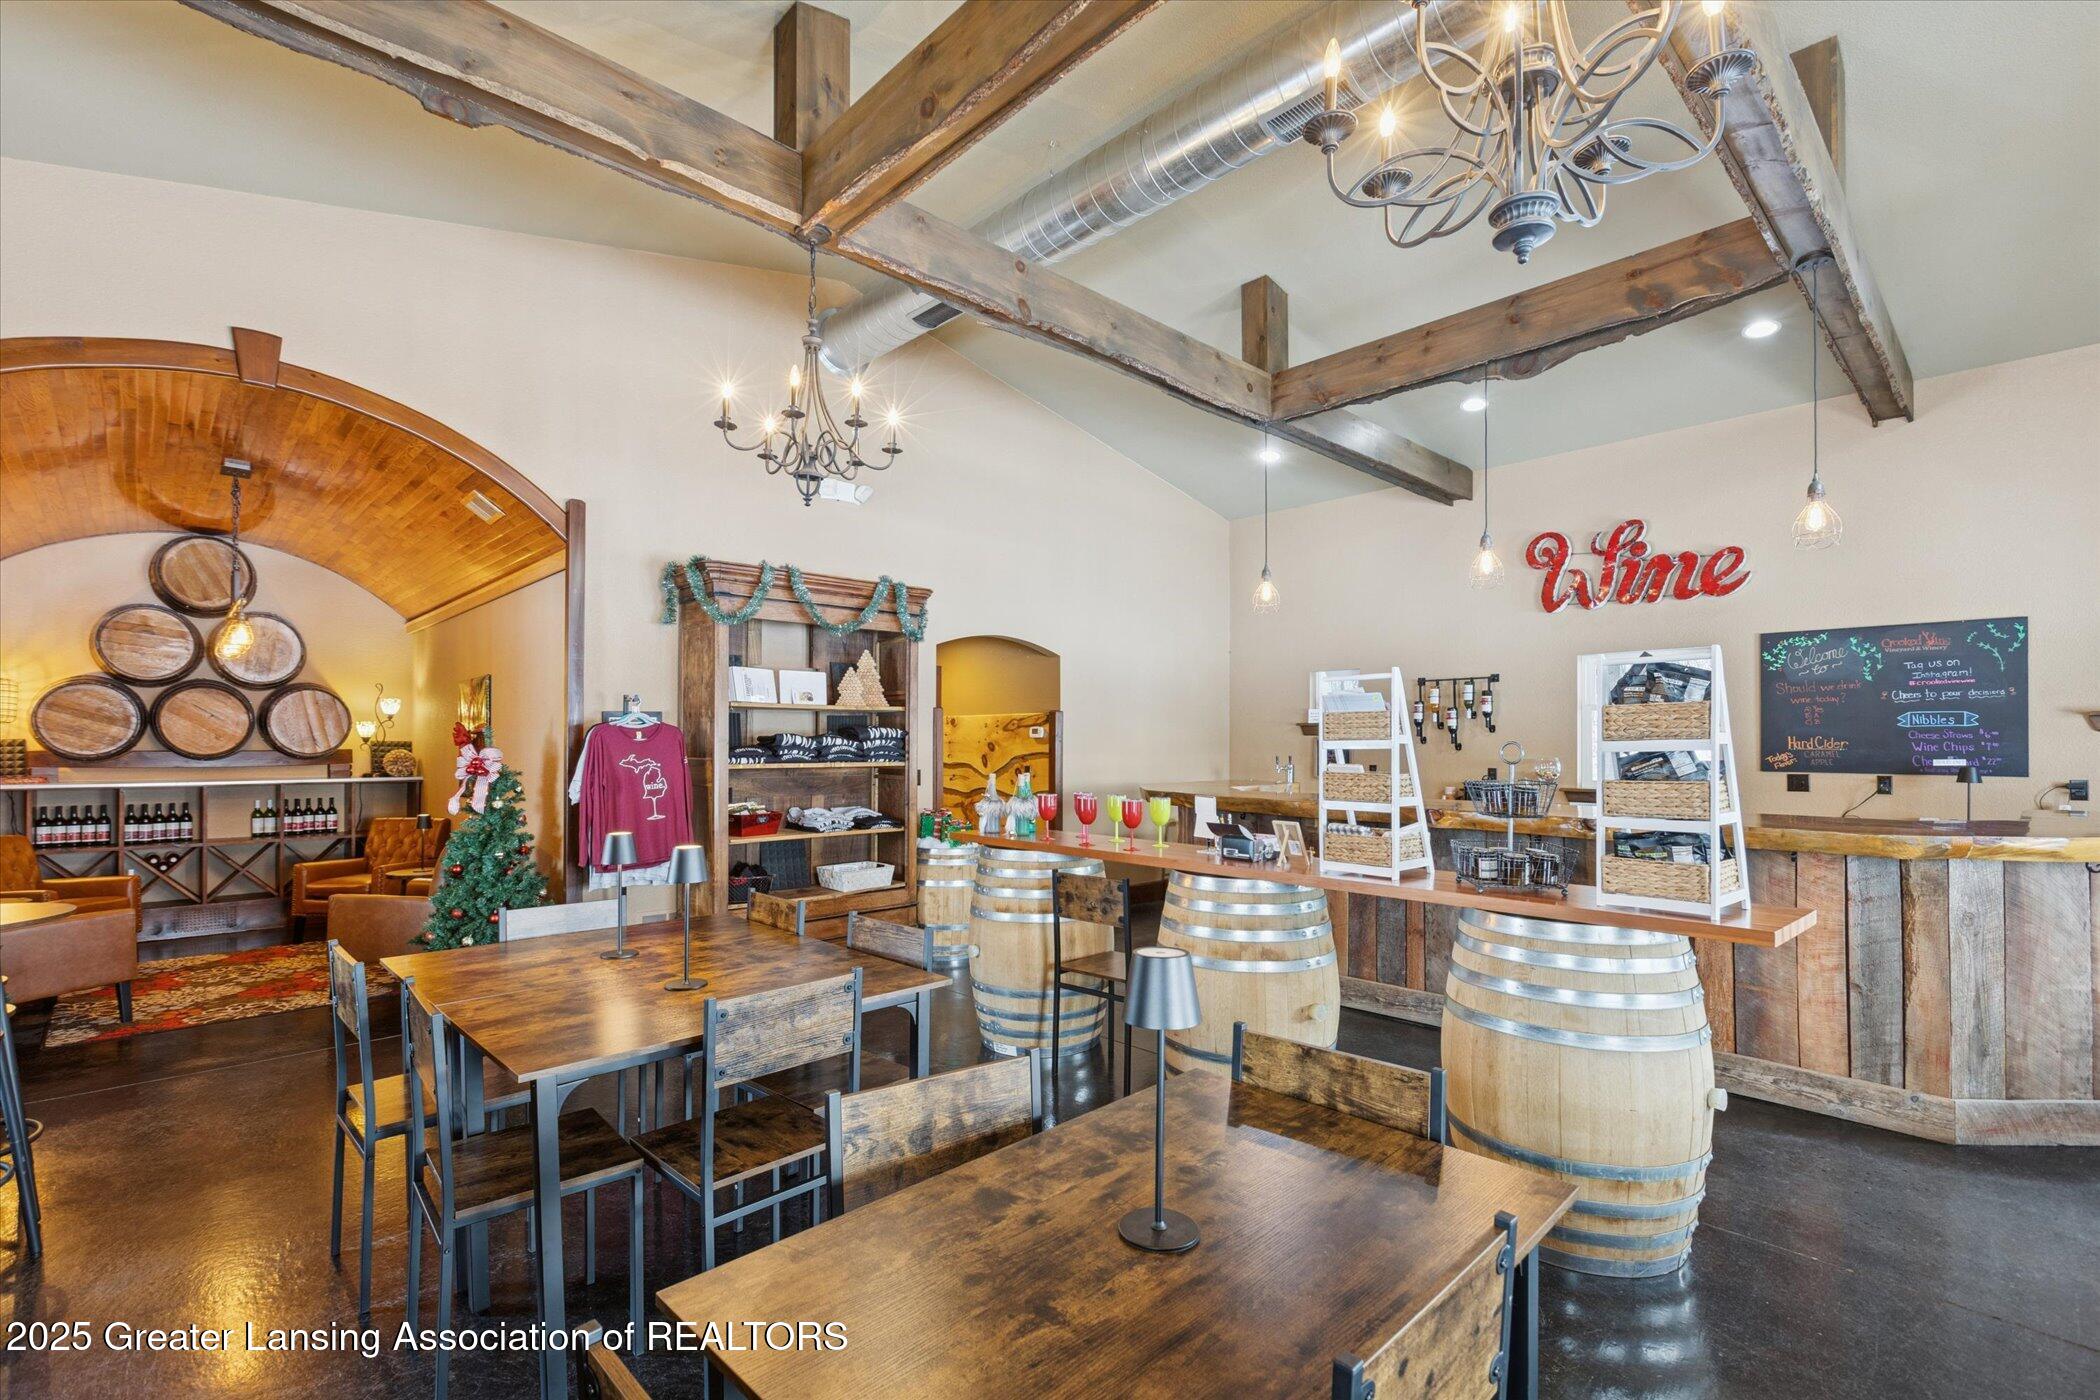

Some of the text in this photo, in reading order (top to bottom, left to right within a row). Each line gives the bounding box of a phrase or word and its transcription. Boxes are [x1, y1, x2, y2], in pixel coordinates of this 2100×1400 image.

[1525, 518, 1751, 613] Wine
[1881, 636, 1921, 648] Crooked
[1787, 647, 1848, 669] Welcome
[1903, 661, 1924, 670] Tag
[1912, 667, 1973, 679] Instagram!
[1775, 680, 1816, 695] Should
[1891, 690, 1922, 699] Cheers
[1925, 689, 1938, 698] to
[1968, 688, 2006, 696] decisions
[1912, 714, 1955, 725] Nibbles
[1908, 730, 1940, 740] Cheese
[1942, 729, 1973, 739] Straws
[1788, 736, 1849, 751] Hard Cider
[1911, 741, 1939, 752] Wine
[1943, 741, 1975, 754] Chips
